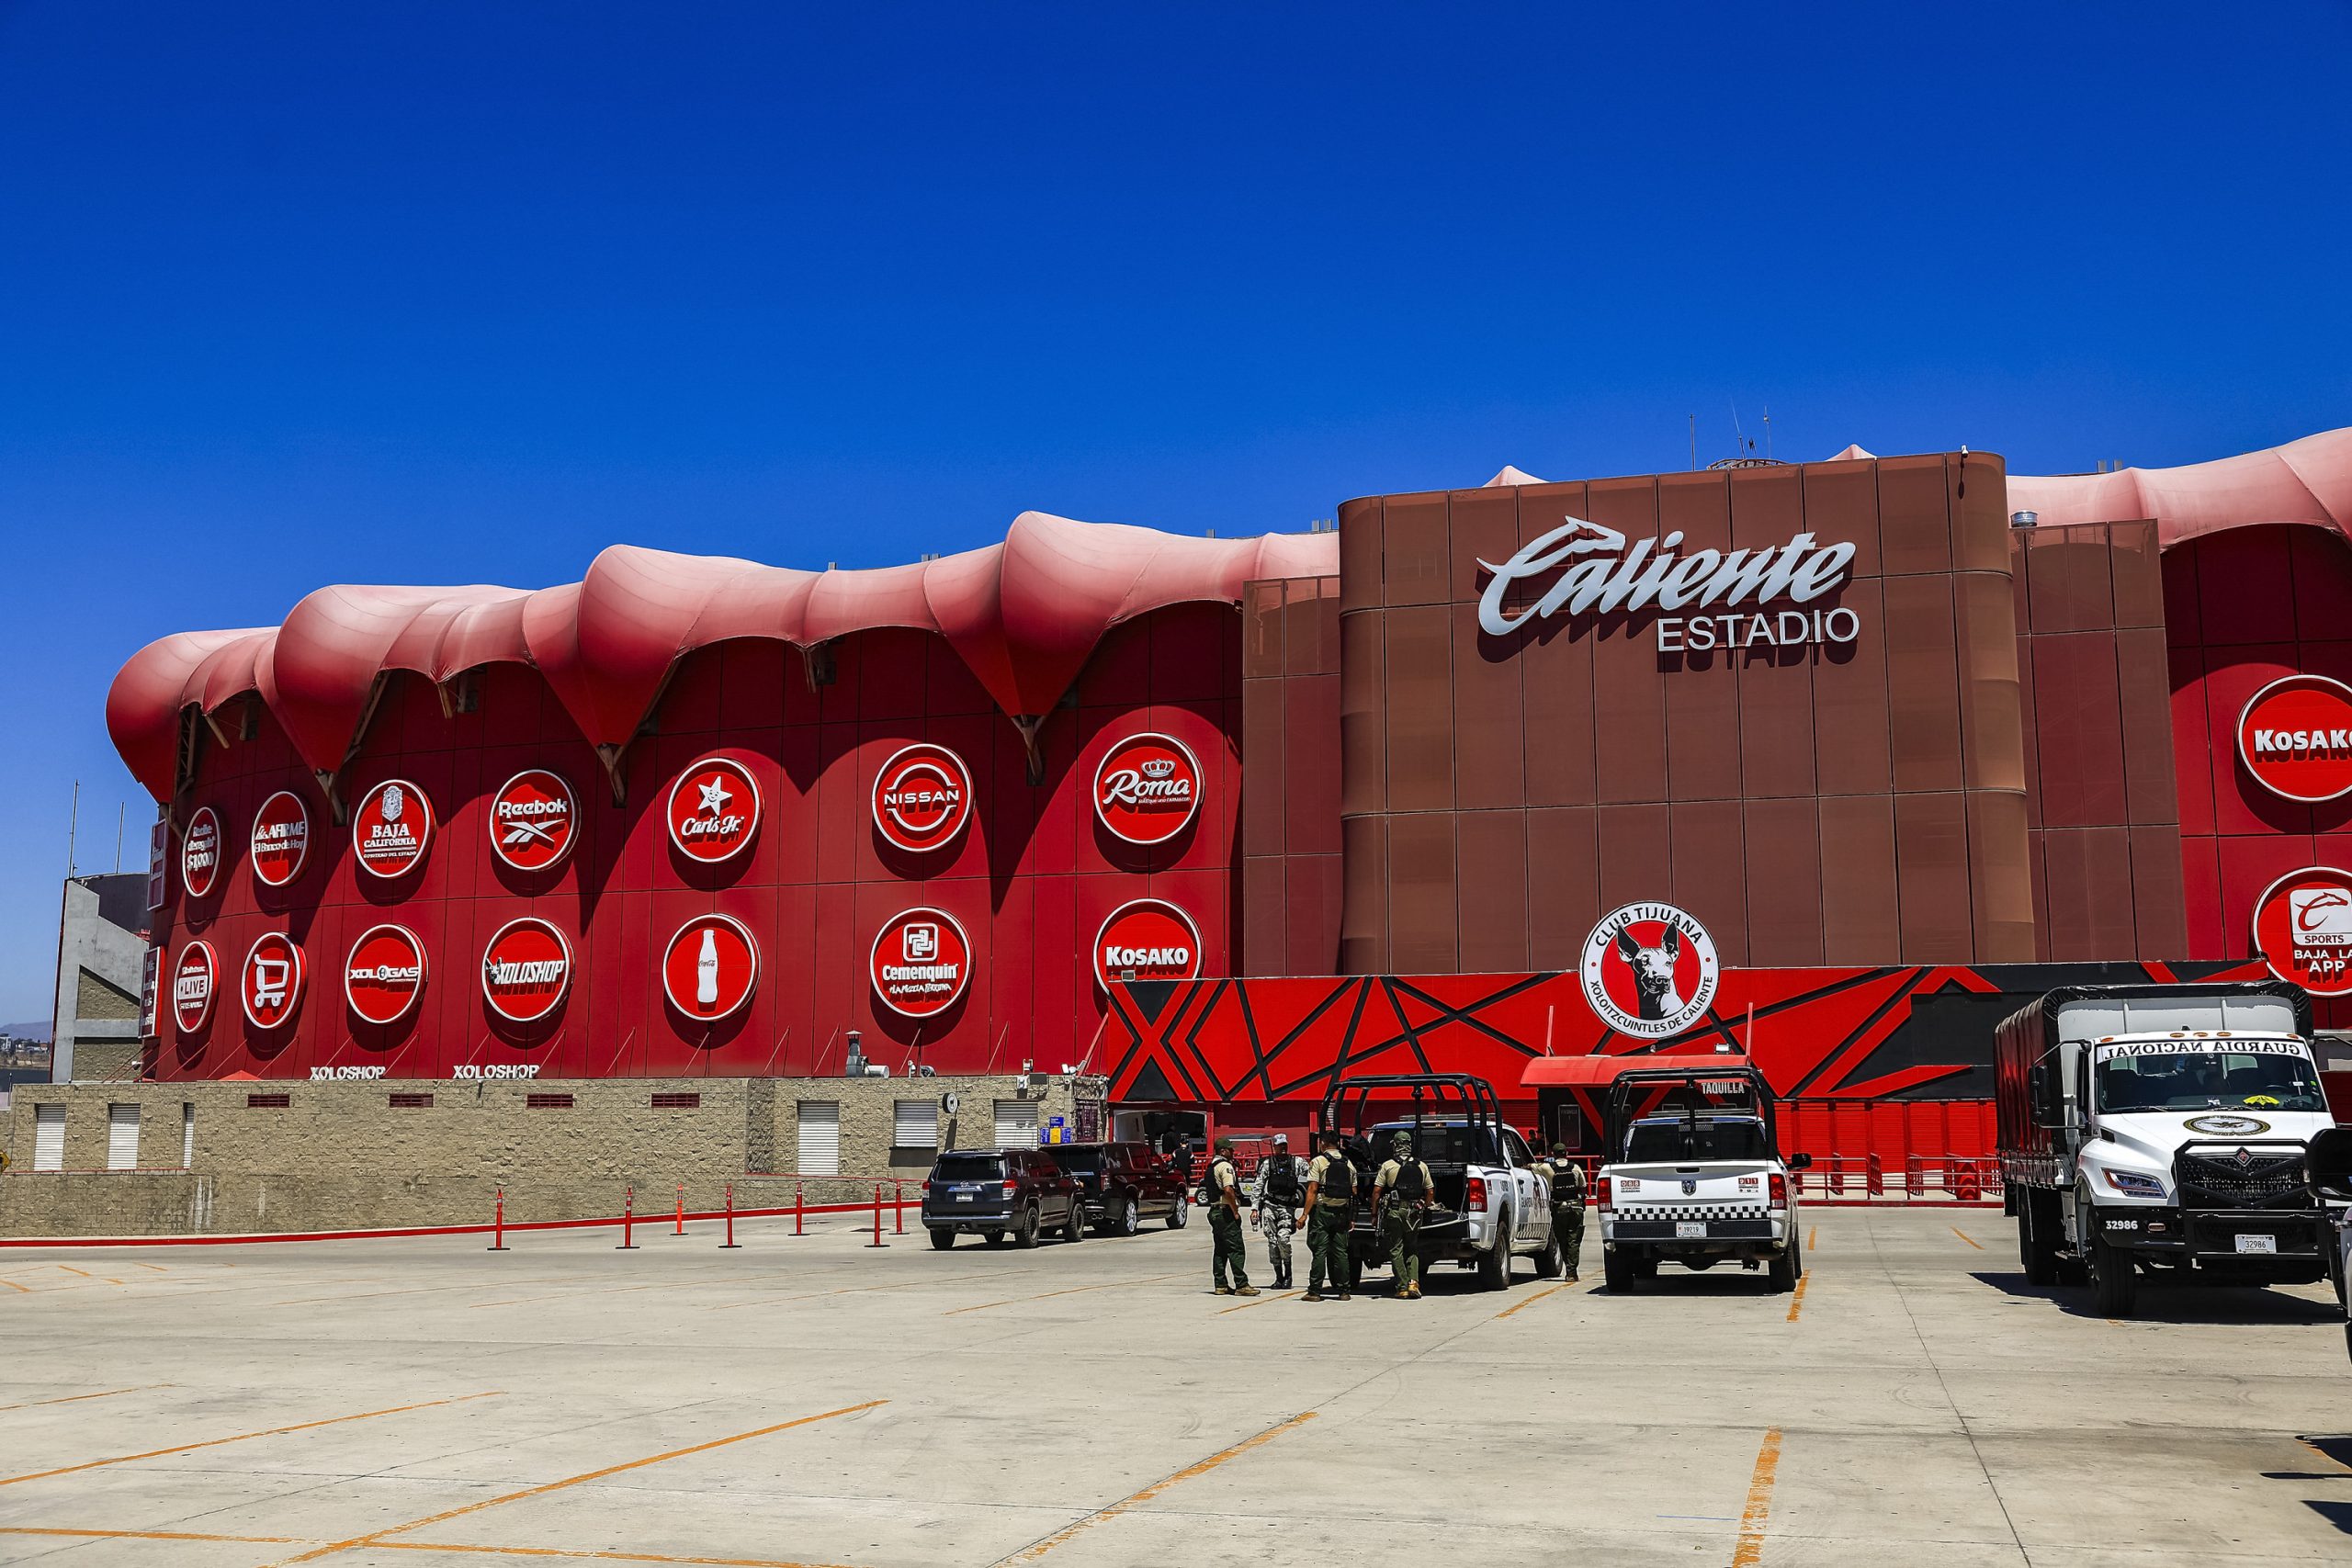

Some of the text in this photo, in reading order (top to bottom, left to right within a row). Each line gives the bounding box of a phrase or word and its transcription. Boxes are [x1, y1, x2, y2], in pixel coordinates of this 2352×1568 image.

[1476, 515, 1856, 636] Caliente
[1657, 608, 1860, 652] ESTADIO
[2255, 729, 2352, 751] KOSAK
[1102, 769, 1190, 804] Roma
[884, 790, 959, 805] NISSAN
[498, 798, 568, 818] Reebok
[269, 821, 305, 839] AFIRME
[372, 823, 410, 838] BAJA
[681, 816, 720, 836] Carl's
[363, 837, 417, 848] CALIFORNIA
[1595, 907, 1702, 947] CLUB TIJUANA
[2304, 934, 2345, 943] SPORTS
[1106, 946, 1189, 965] KOSAKO
[2294, 949, 2330, 959] BAJA
[494, 960, 566, 985] XOLOSHOP
[2309, 960, 2346, 972] APP
[185, 979, 205, 994] LIVE
[1590, 976, 1713, 1033] XOLOITZCUINTLES DE CALIENTE
[308, 1066, 386, 1080] XOLOSHOP
[453, 1065, 540, 1079] XOLOSHOP
[1702, 1082, 1745, 1094] TAQUILLA
[2105, 1220, 2138, 1230] 32986
[2245, 1240, 2267, 1248] 32986
